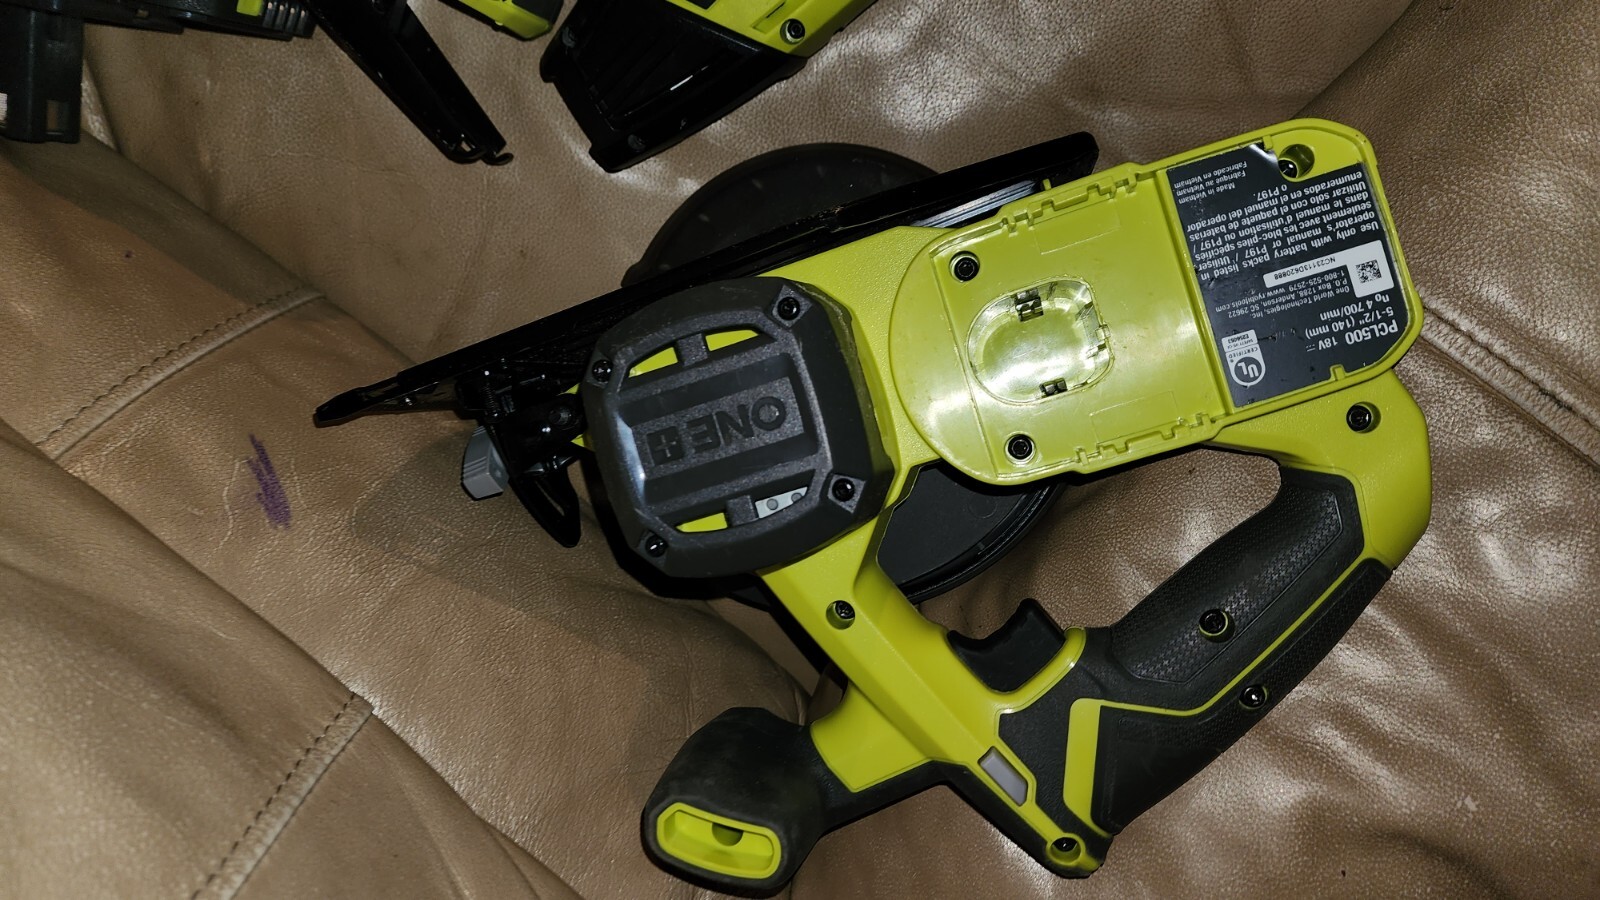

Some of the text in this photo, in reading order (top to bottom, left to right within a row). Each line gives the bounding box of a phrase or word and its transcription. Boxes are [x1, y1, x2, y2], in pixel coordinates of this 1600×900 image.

[1212, 160, 1247, 176] Fabricado
[1173, 175, 1203, 189] Vietnam
[1176, 183, 1205, 196] Vietnam
[1205, 179, 1214, 187] au
[1215, 181, 1235, 192] Made
[1332, 181, 1366, 197] Utilizar
[1178, 191, 1207, 204] Vietnam
[1253, 186, 1280, 201] P197.
[1344, 190, 1368, 204] dans
[1186, 171, 1362, 232] enumerados en el manuel del operador
[1290, 199, 1308, 210] con
[1333, 199, 1343, 208] le
[1241, 206, 1278, 225] paquete
[1279, 205, 1289, 215] el
[1295, 202, 1330, 221] manuel
[1227, 220, 1239, 230] de
[1238, 214, 1293, 237] d'utilisation
[1326, 210, 1375, 232] operator's
[1193, 200, 1372, 261] seulement avec les bloc-piles spécifiés
[1223, 232, 1236, 241] ou
[1286, 227, 1322, 245] manual
[1200, 236, 1222, 251] P197
[1200, 220, 1379, 280] Use only with battery packs listed in
[1244, 243, 1267, 258] P197
[1272, 239, 1282, 248] or
[1198, 255, 1230, 271] Utiliser
[1288, 269, 1345, 292] 1-800-525-2579
[1317, 282, 1332, 290] Box
[1249, 285, 1350, 318] One World Technologies, Inc.
[1260, 292, 1295, 307] Anderson,
[1227, 306, 1249, 318] 29622
[1249, 303, 1259, 312] SC
[1319, 301, 1364, 321] 700/min
[1331, 315, 1355, 332] (140
[1304, 324, 1329, 339] mm)
[1318, 319, 1398, 350] PCL500 18V
[1237, 361, 1259, 378] UL
